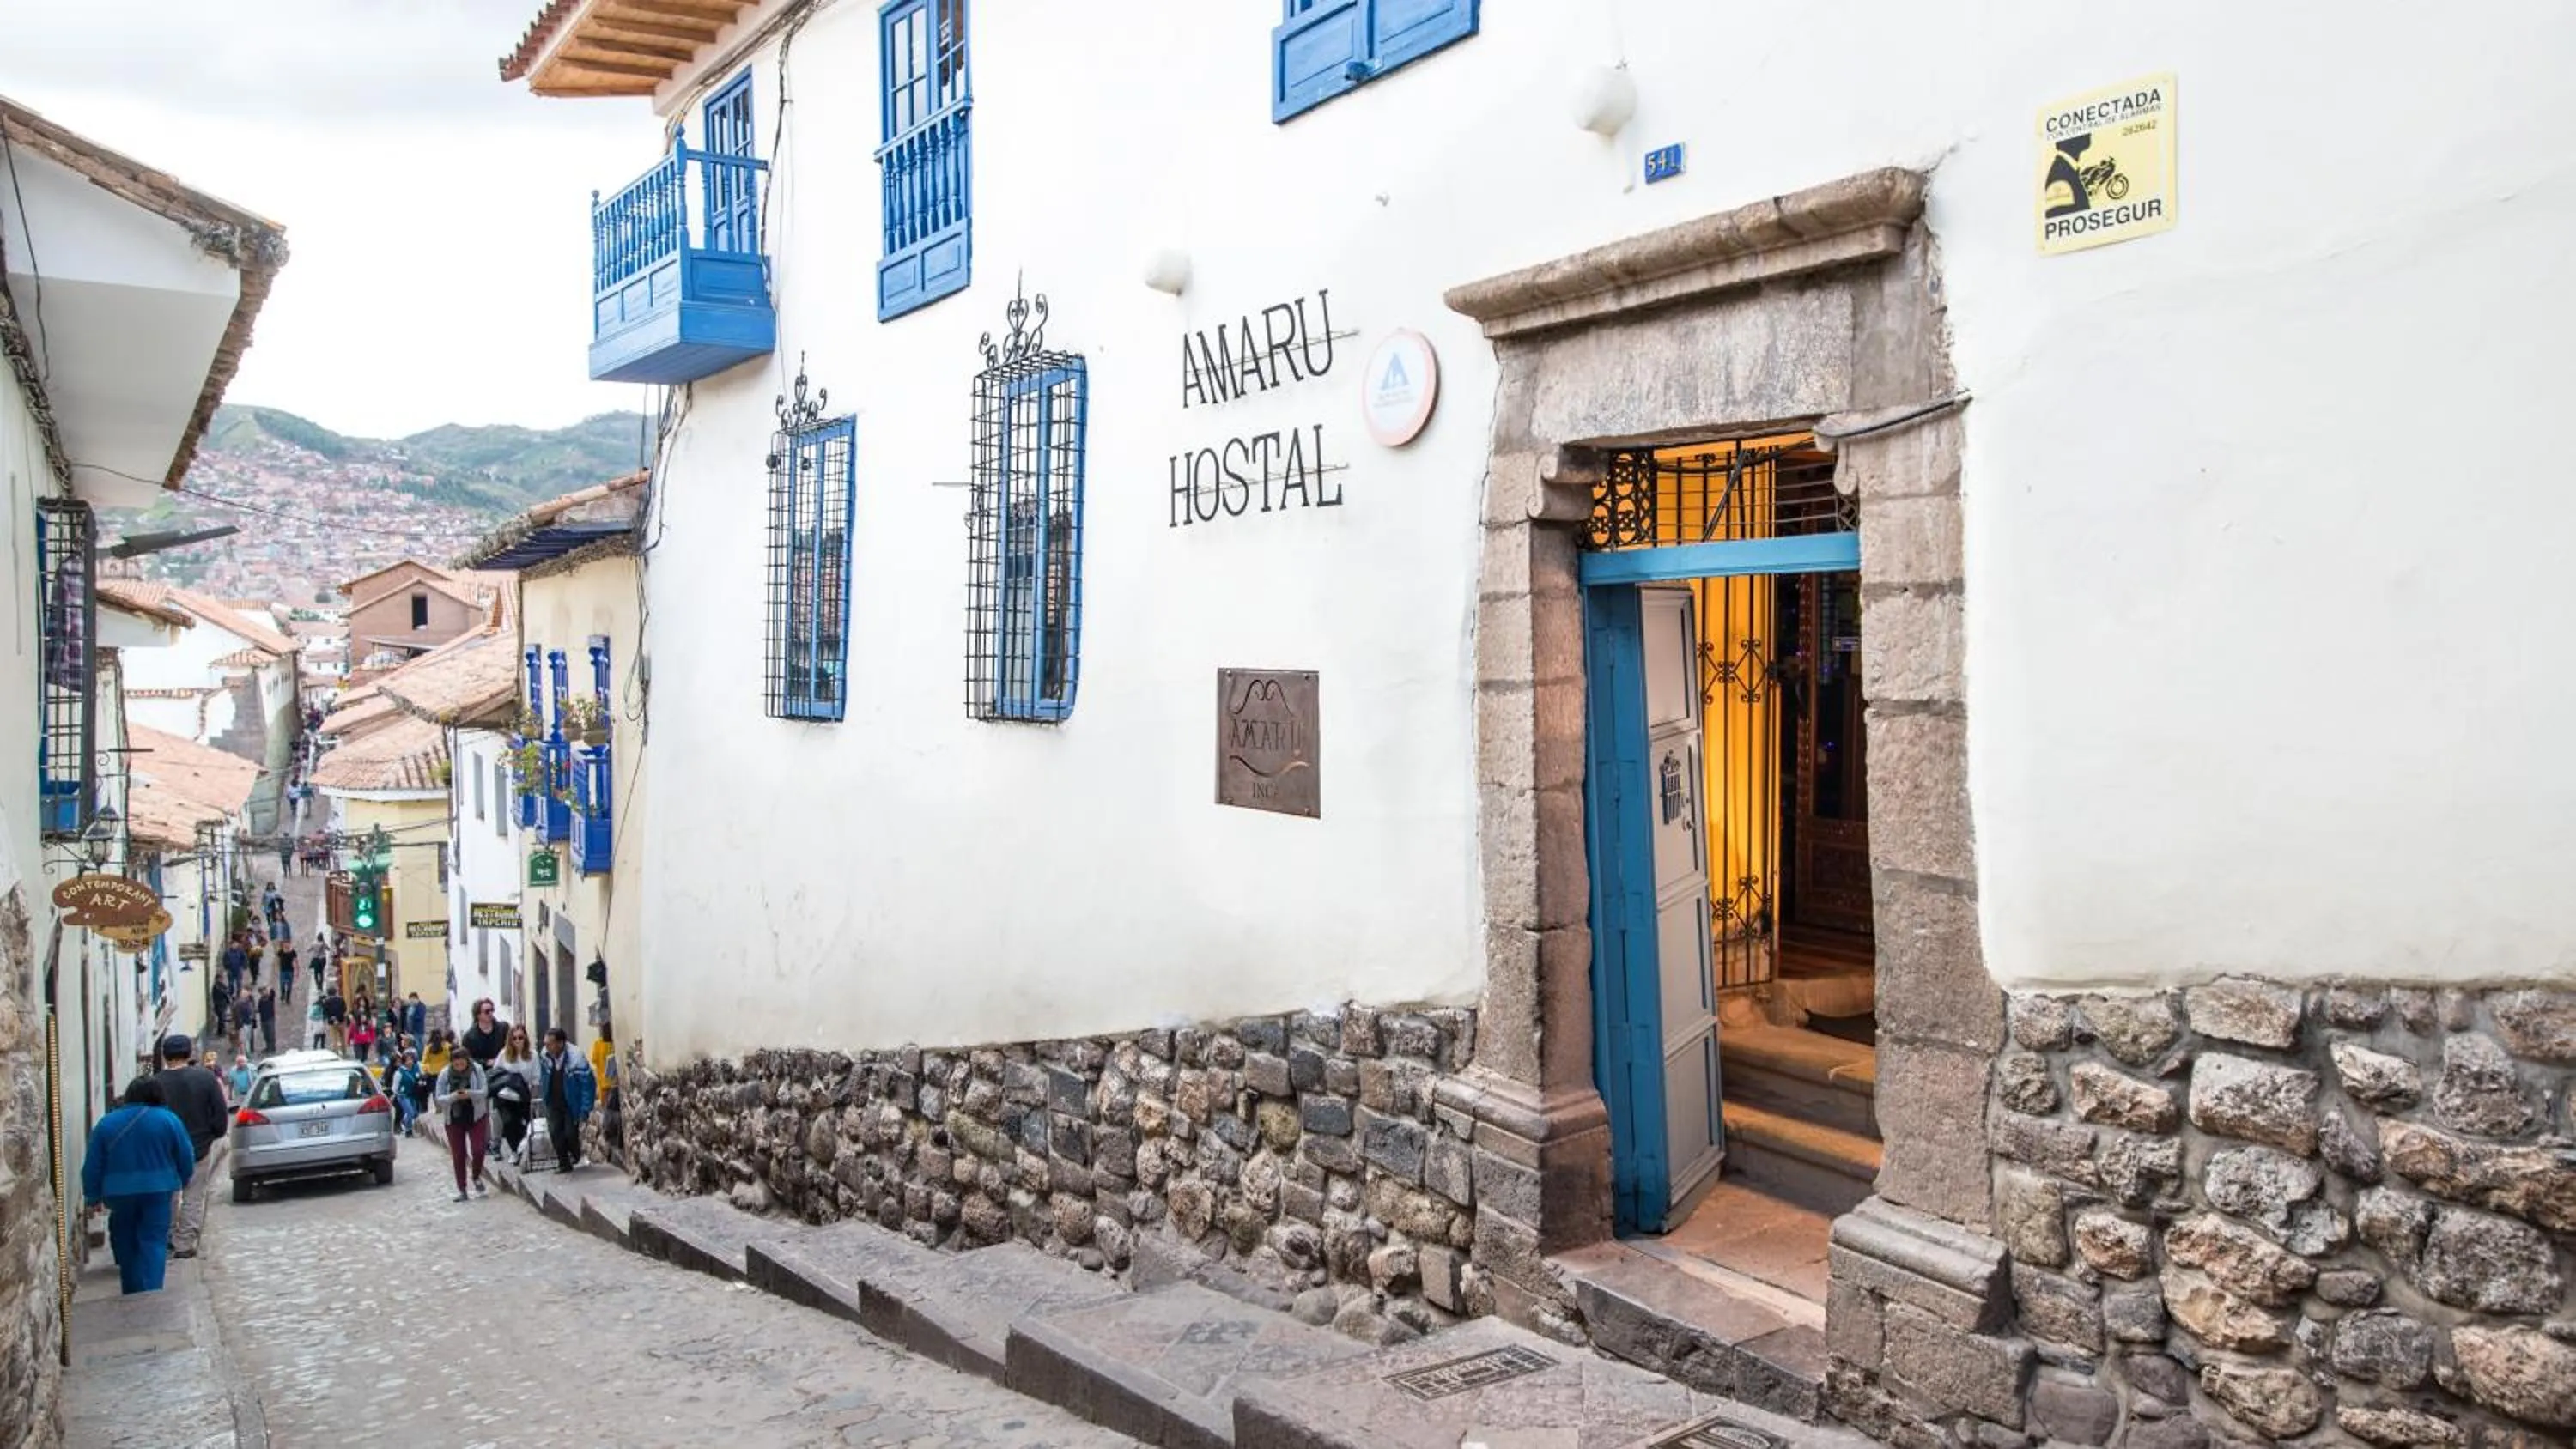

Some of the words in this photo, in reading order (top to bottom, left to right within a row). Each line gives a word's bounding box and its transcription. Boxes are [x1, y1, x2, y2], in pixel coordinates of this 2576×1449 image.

[2046, 88, 2161, 132] CONECTADA
[2045, 198, 2161, 239] PROSEGUR
[1182, 288, 1334, 409] AMARU
[1169, 424, 1343, 528] HOSTAL
[1230, 718, 1302, 751] AMARU
[88, 892, 131, 911] ART
